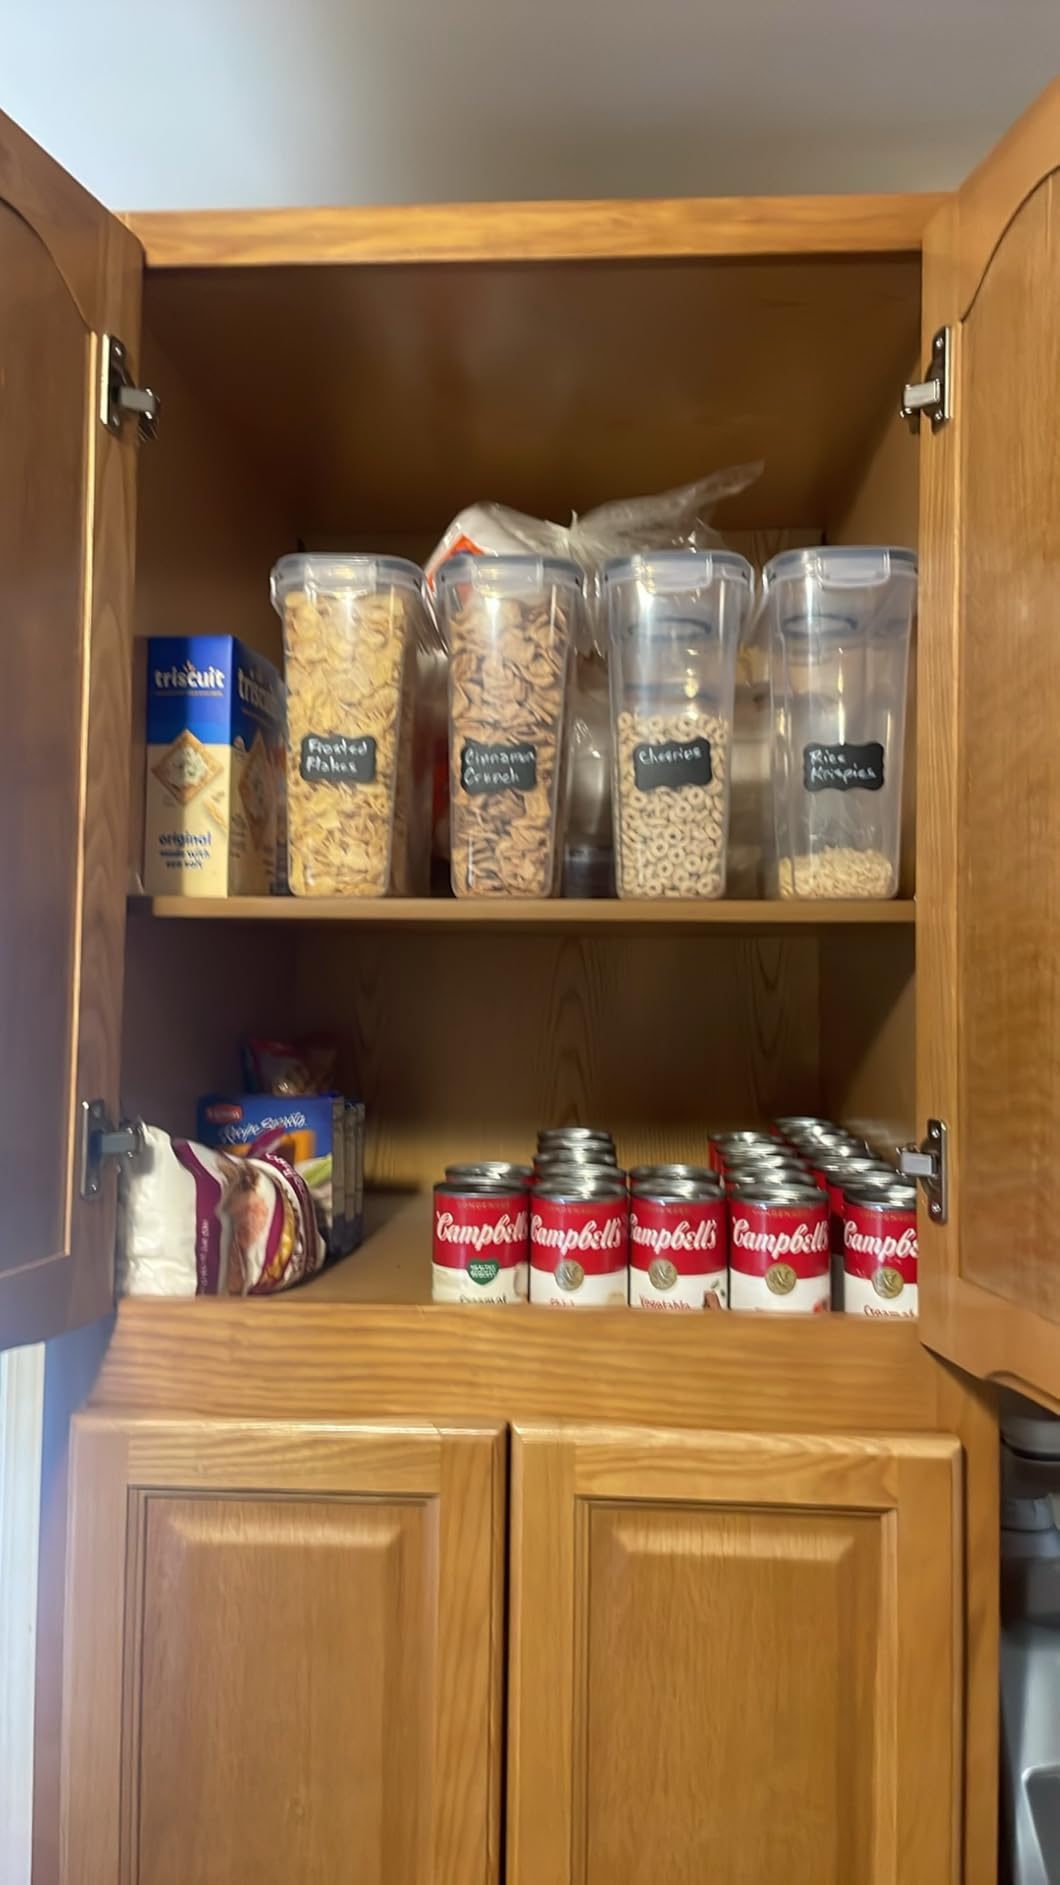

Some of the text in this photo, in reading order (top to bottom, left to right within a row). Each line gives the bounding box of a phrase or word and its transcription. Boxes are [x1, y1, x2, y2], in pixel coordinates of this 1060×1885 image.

[154, 665, 225, 689] triscuit
[306, 755, 358, 774] Flakes
[638, 746, 702, 765] Cheerios
[809, 749, 846, 765] Rice
[530, 1214, 622, 1256] Campbell's
[732, 1216, 828, 1260] Campbell's
[843, 1219, 918, 1263] Campbe
